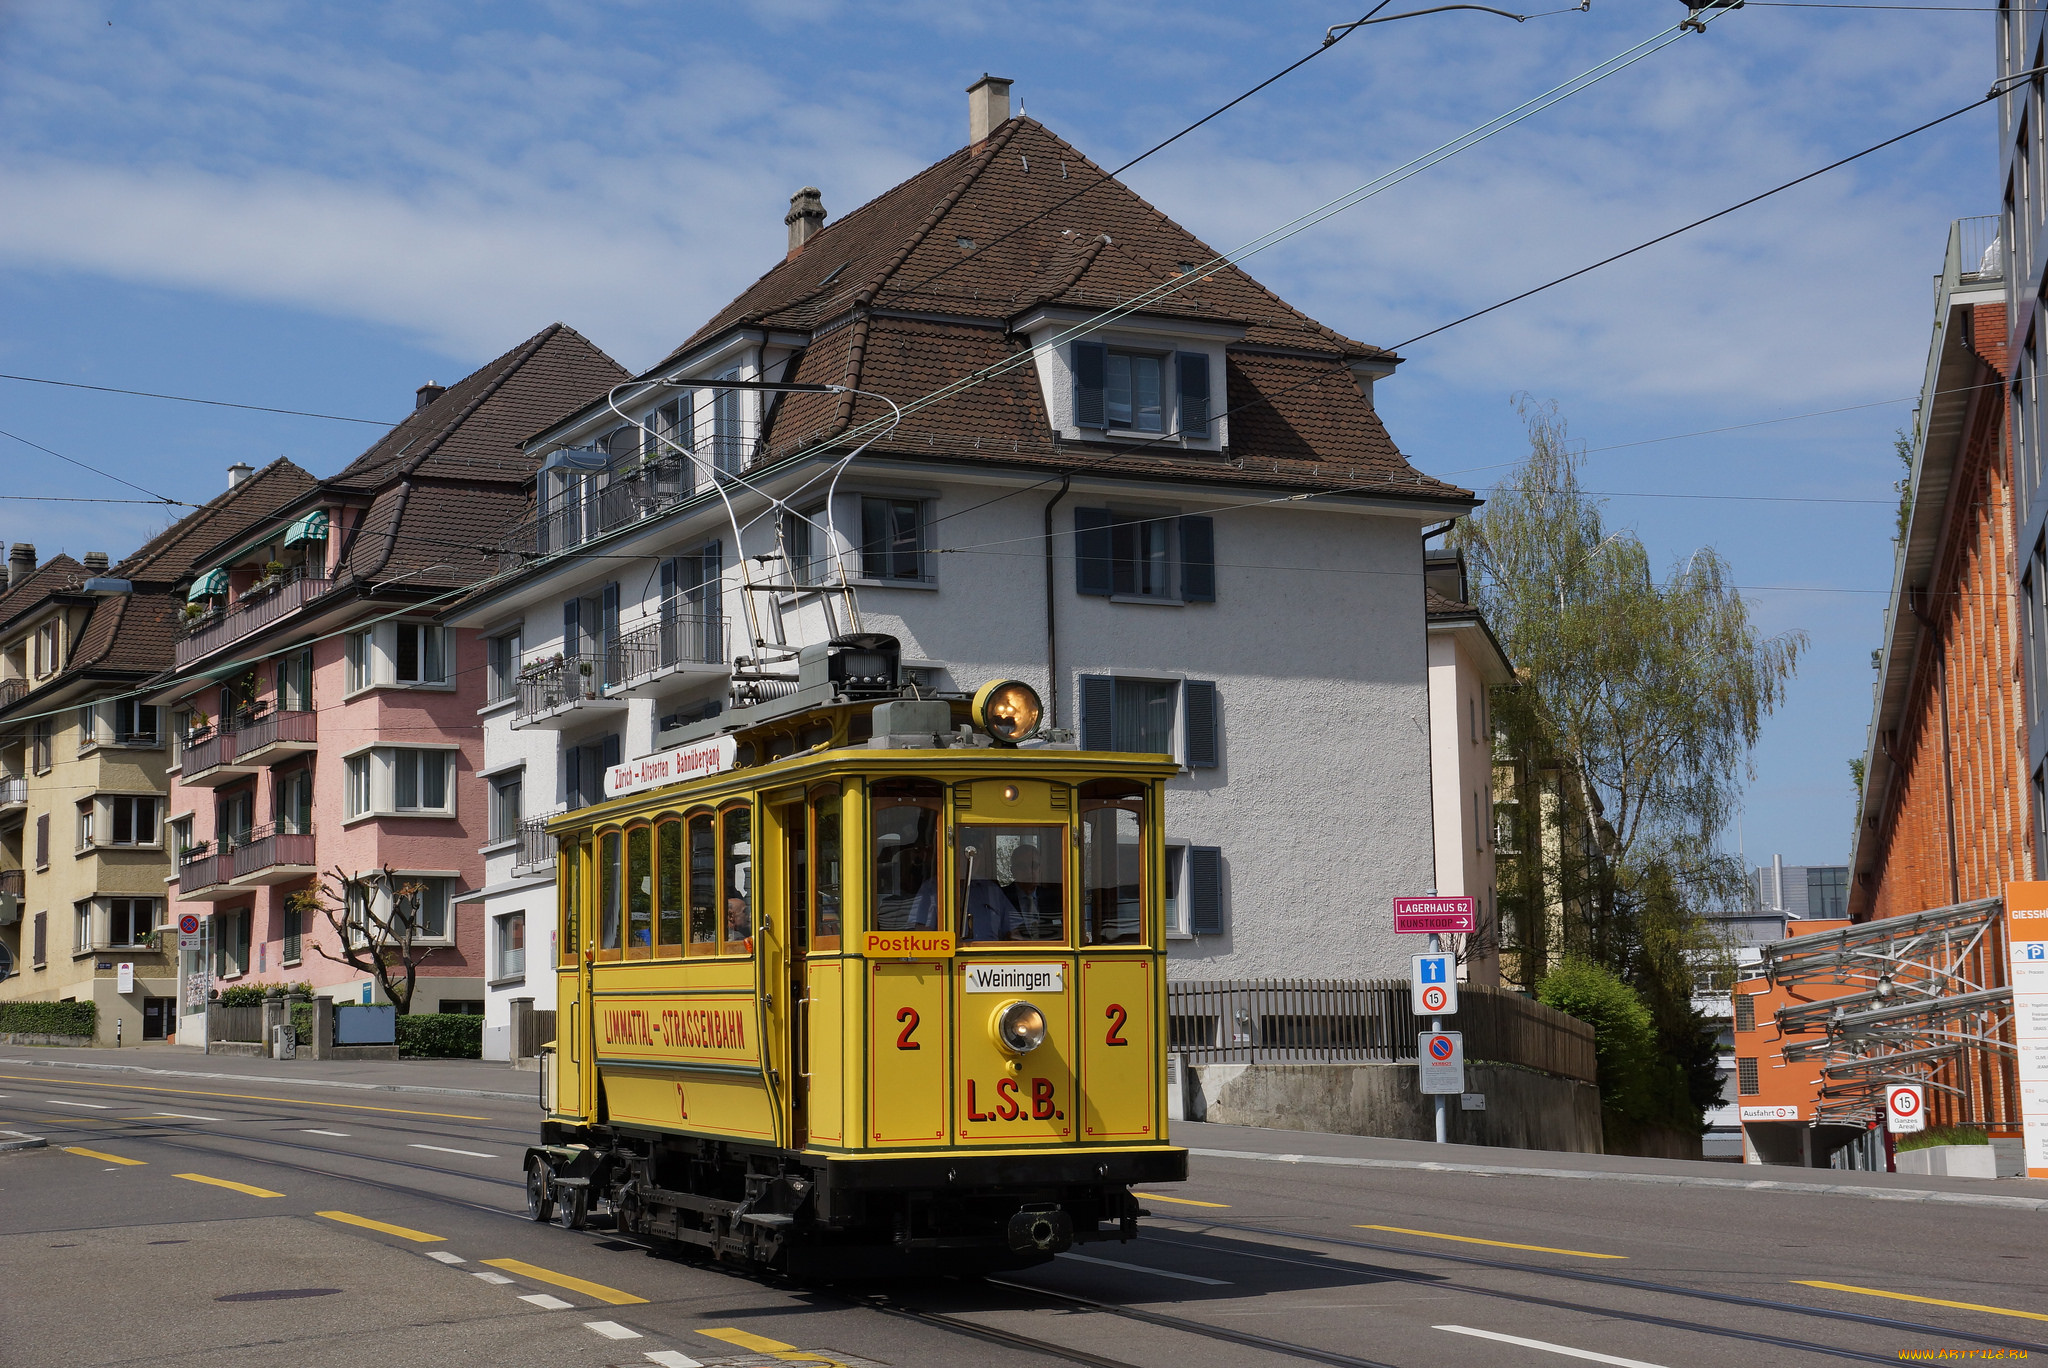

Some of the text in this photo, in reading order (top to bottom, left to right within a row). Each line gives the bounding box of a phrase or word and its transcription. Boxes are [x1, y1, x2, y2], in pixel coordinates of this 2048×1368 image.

[614, 766, 633, 790] Zürich
[640, 760, 669, 783] Altstetten
[676, 745, 720, 775] Bahnübergang
[1399, 903, 1468, 914] LAGERHAUS 62
[1400, 918, 1453, 928] KUNSTKOOP
[867, 935, 951, 951] Postkurs
[976, 968, 1051, 991] Weiningen
[1429, 993, 1439, 1004] 15
[896, 1006, 920, 1050] 2
[1105, 1003, 1128, 1047] 2
[676, 1082, 688, 1120] 2
[966, 1077, 1065, 1122] L.S.B.
[1899, 1096, 1911, 1109] 15
[1743, 1109, 1775, 1117] Ausfahrt
